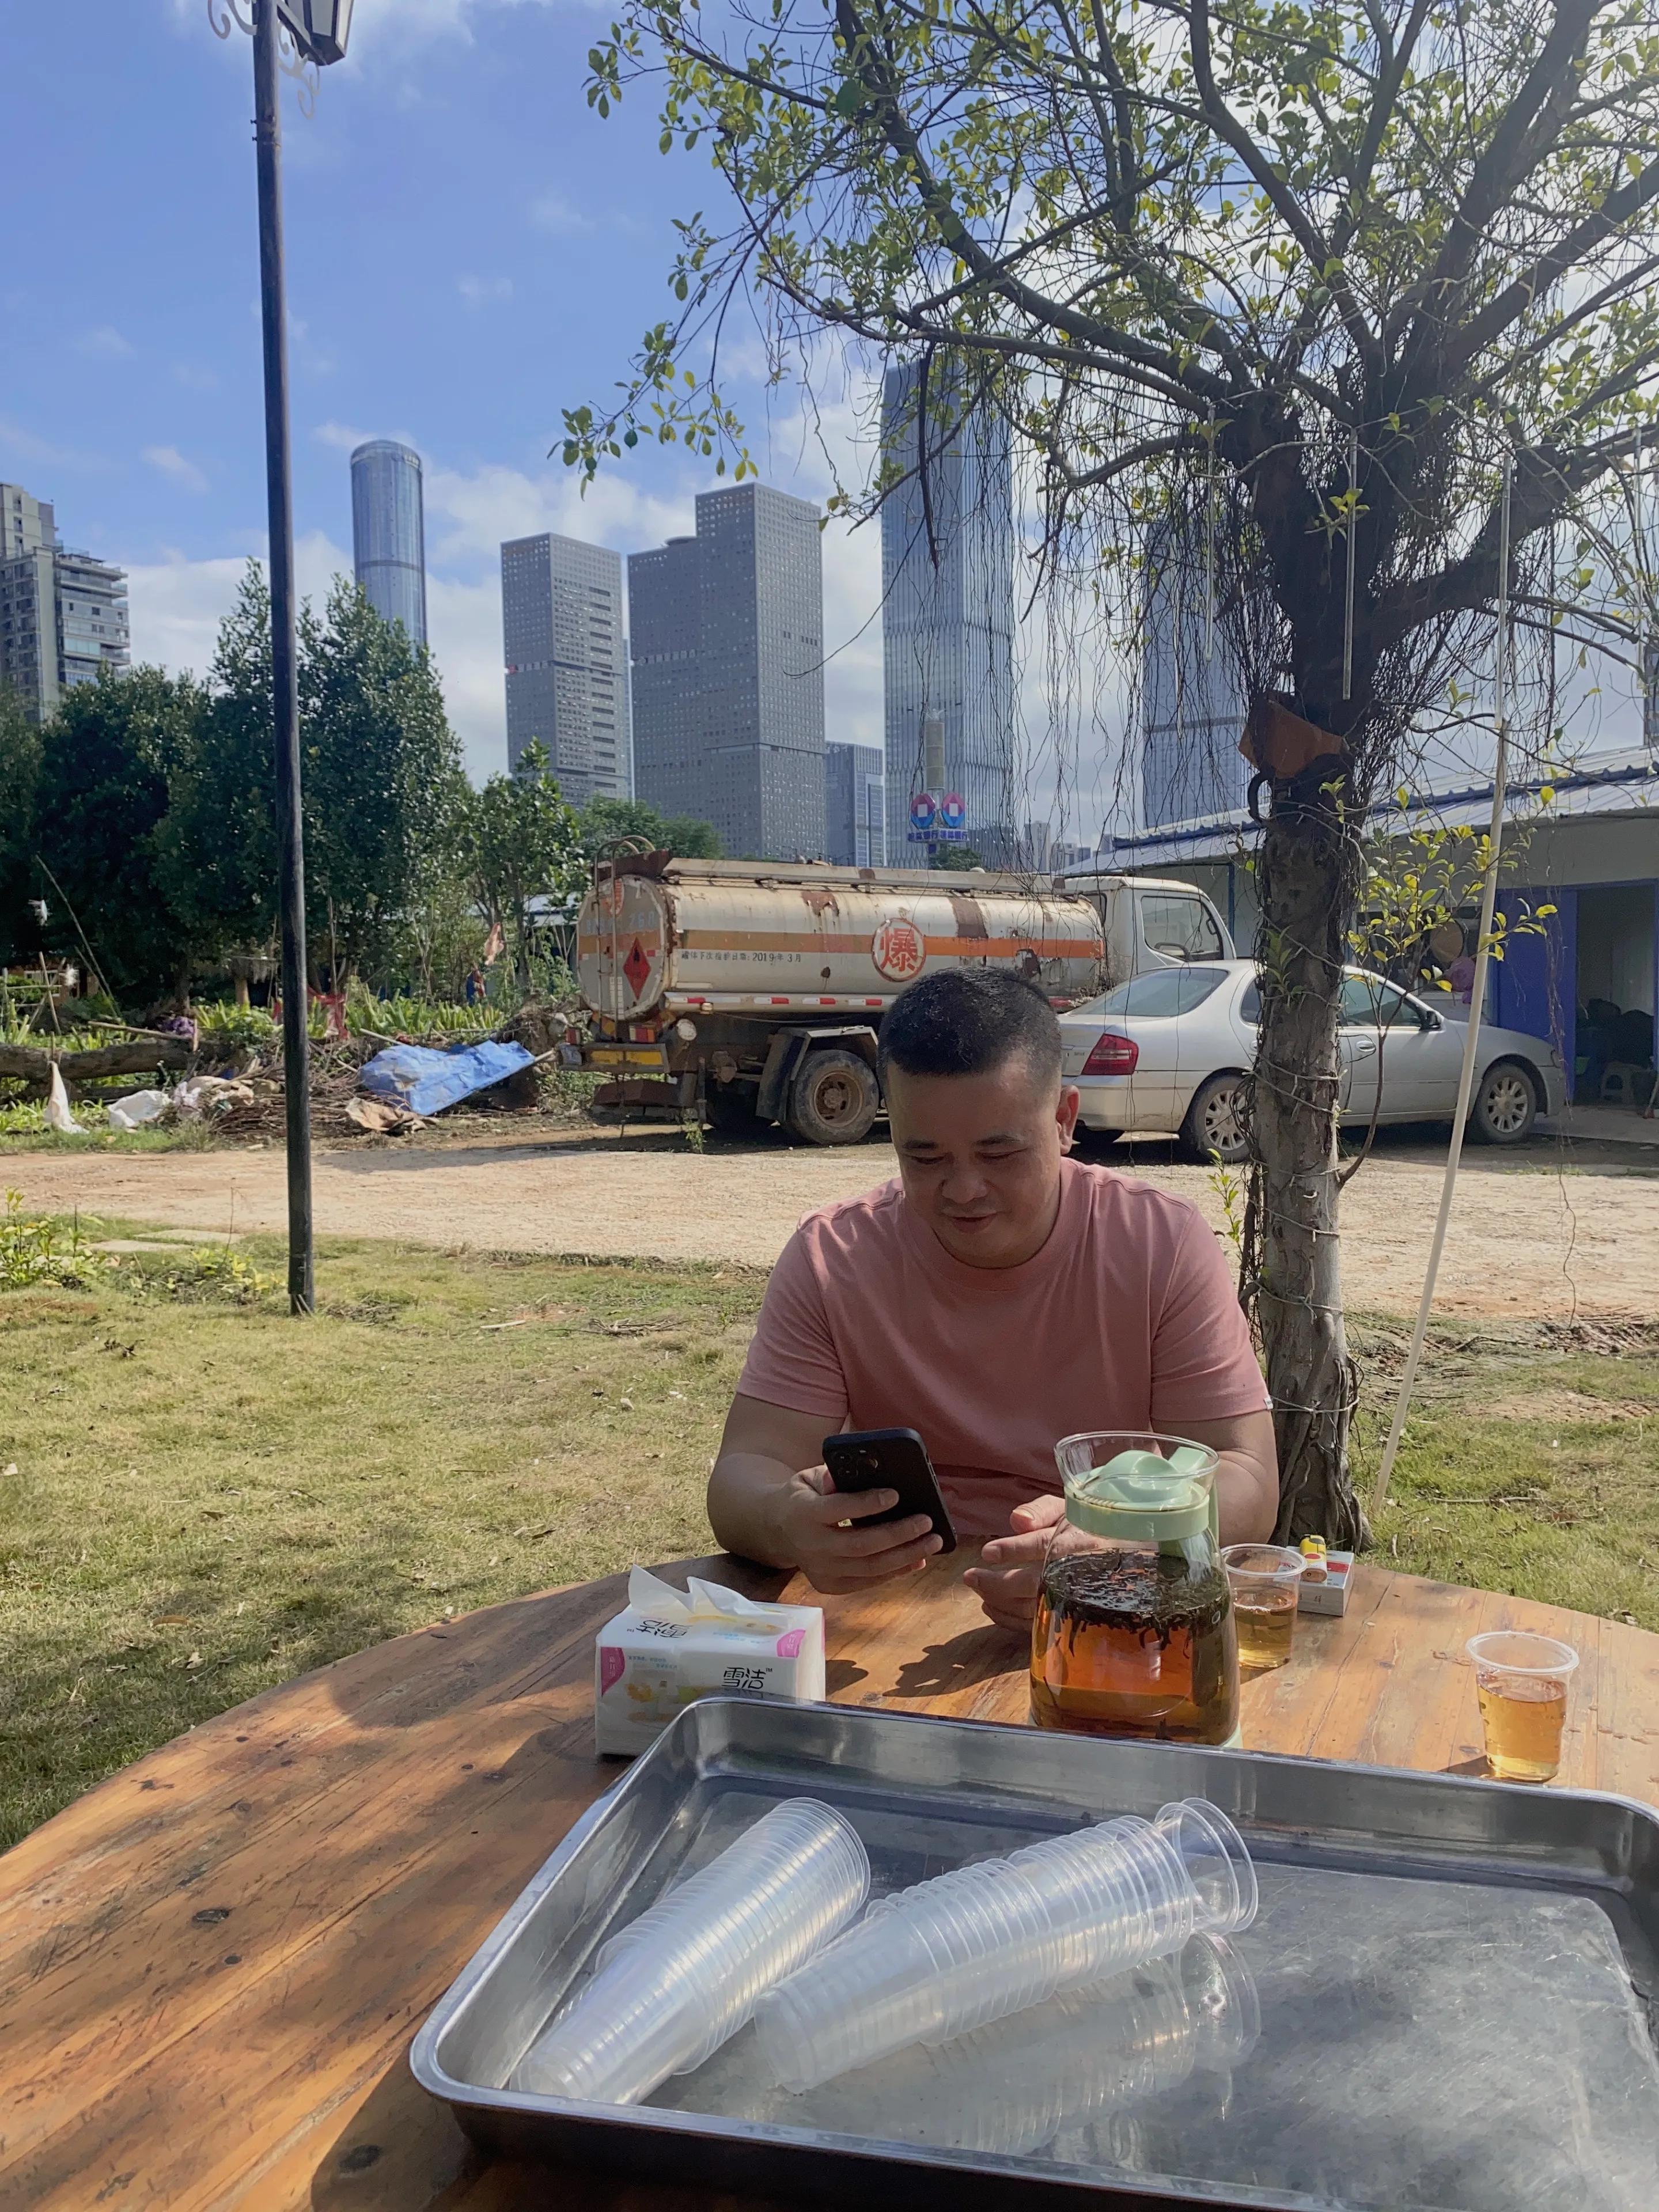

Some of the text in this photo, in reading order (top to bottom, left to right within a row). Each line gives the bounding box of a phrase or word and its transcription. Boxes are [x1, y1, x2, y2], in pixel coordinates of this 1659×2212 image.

[879, 926, 918, 972] 爆
[635, 1619, 694, 1638] 雪洁
[721, 1666, 766, 1690] 雪洁
